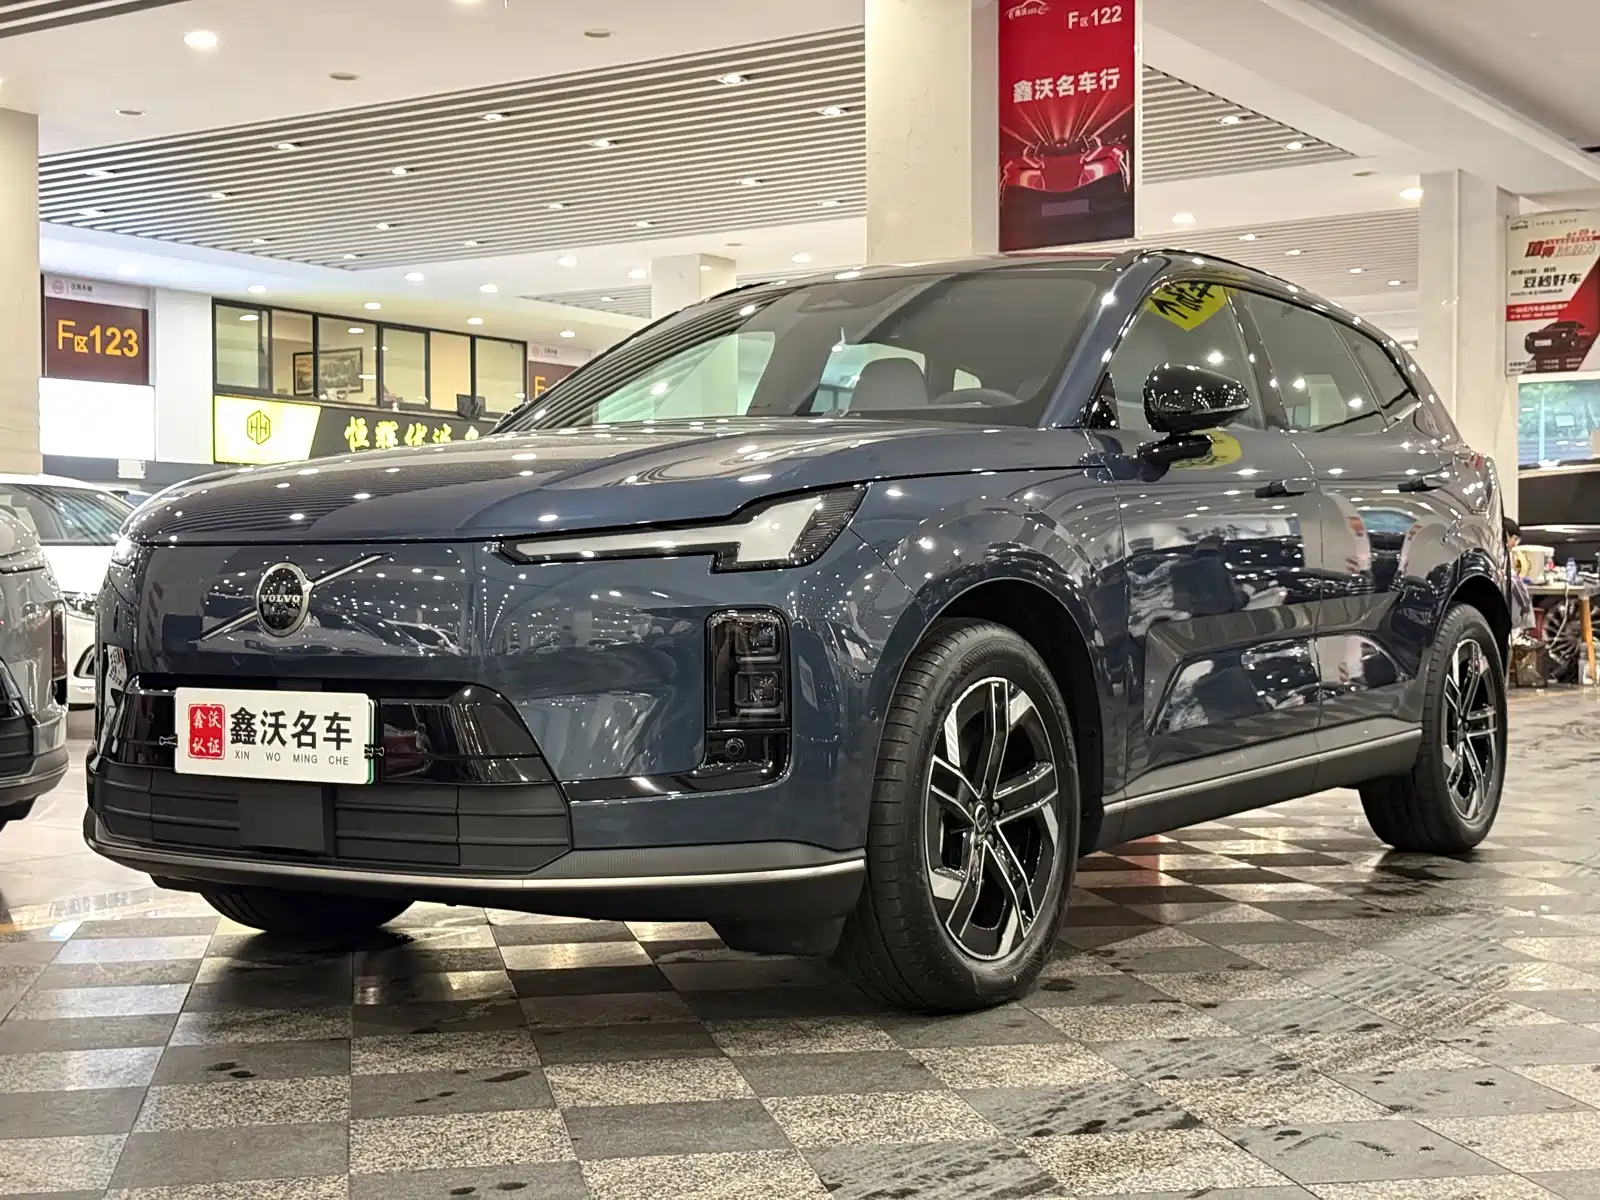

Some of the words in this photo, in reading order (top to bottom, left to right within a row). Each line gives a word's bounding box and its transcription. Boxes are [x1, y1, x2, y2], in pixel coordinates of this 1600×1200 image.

[1013, 67, 1121, 103] 鑫沃名车行
[57, 319, 139, 358] F区123
[260, 594, 301, 603] VOLVO
[192, 708, 222, 729] 鑫沃
[230, 707, 352, 750] 鑫沃名车
[192, 737, 221, 754] 认证
[235, 750, 250, 760] XIN
[266, 752, 281, 762] WO
[293, 754, 318, 764] MING
[328, 755, 349, 765] CHE
